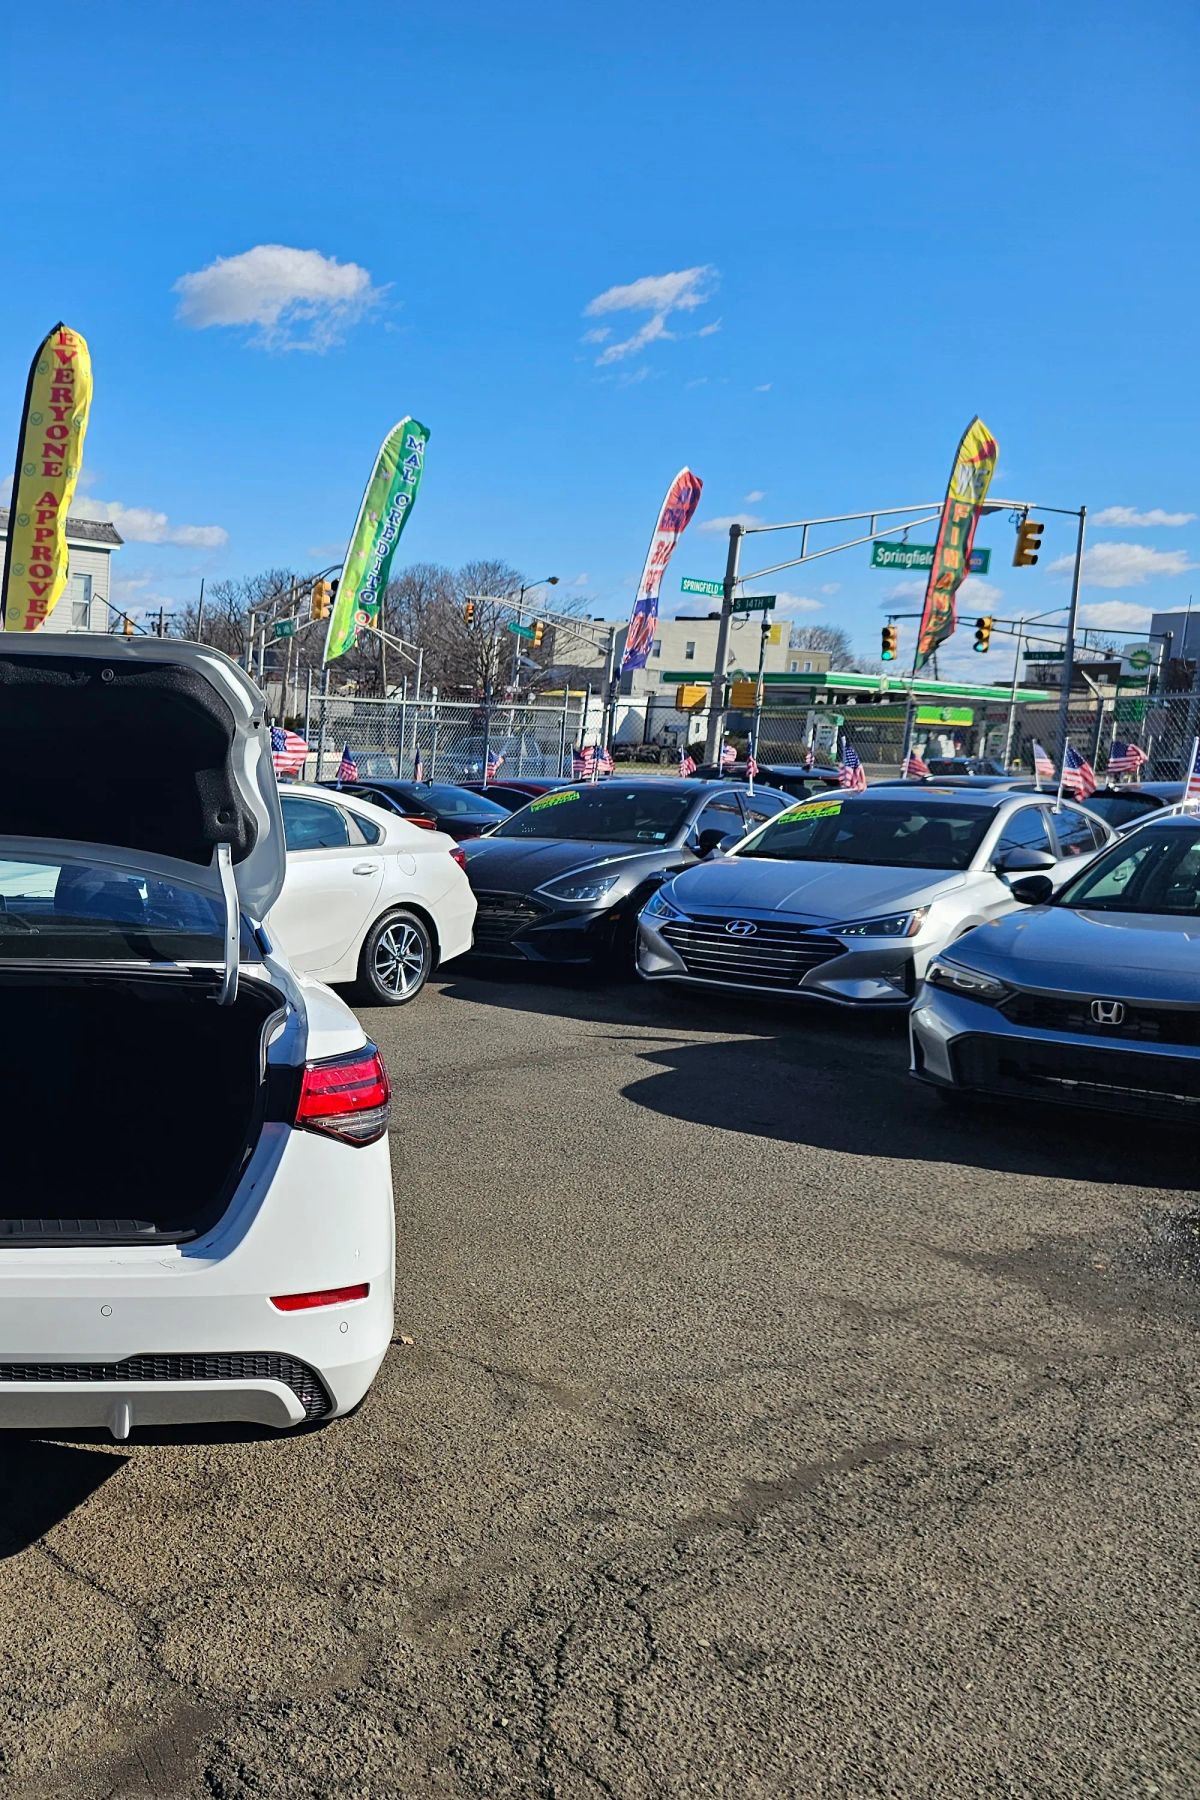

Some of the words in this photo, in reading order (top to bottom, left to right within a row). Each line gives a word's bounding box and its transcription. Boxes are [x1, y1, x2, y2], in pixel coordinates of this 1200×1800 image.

[41, 332, 78, 477] EVERYONE
[402, 435, 424, 484] MAL
[359, 493, 411, 605] CREDITO
[683, 579, 719, 594] SPRINGFIELD
[735, 600, 741, 610] S
[746, 598, 764, 609] 14TH
